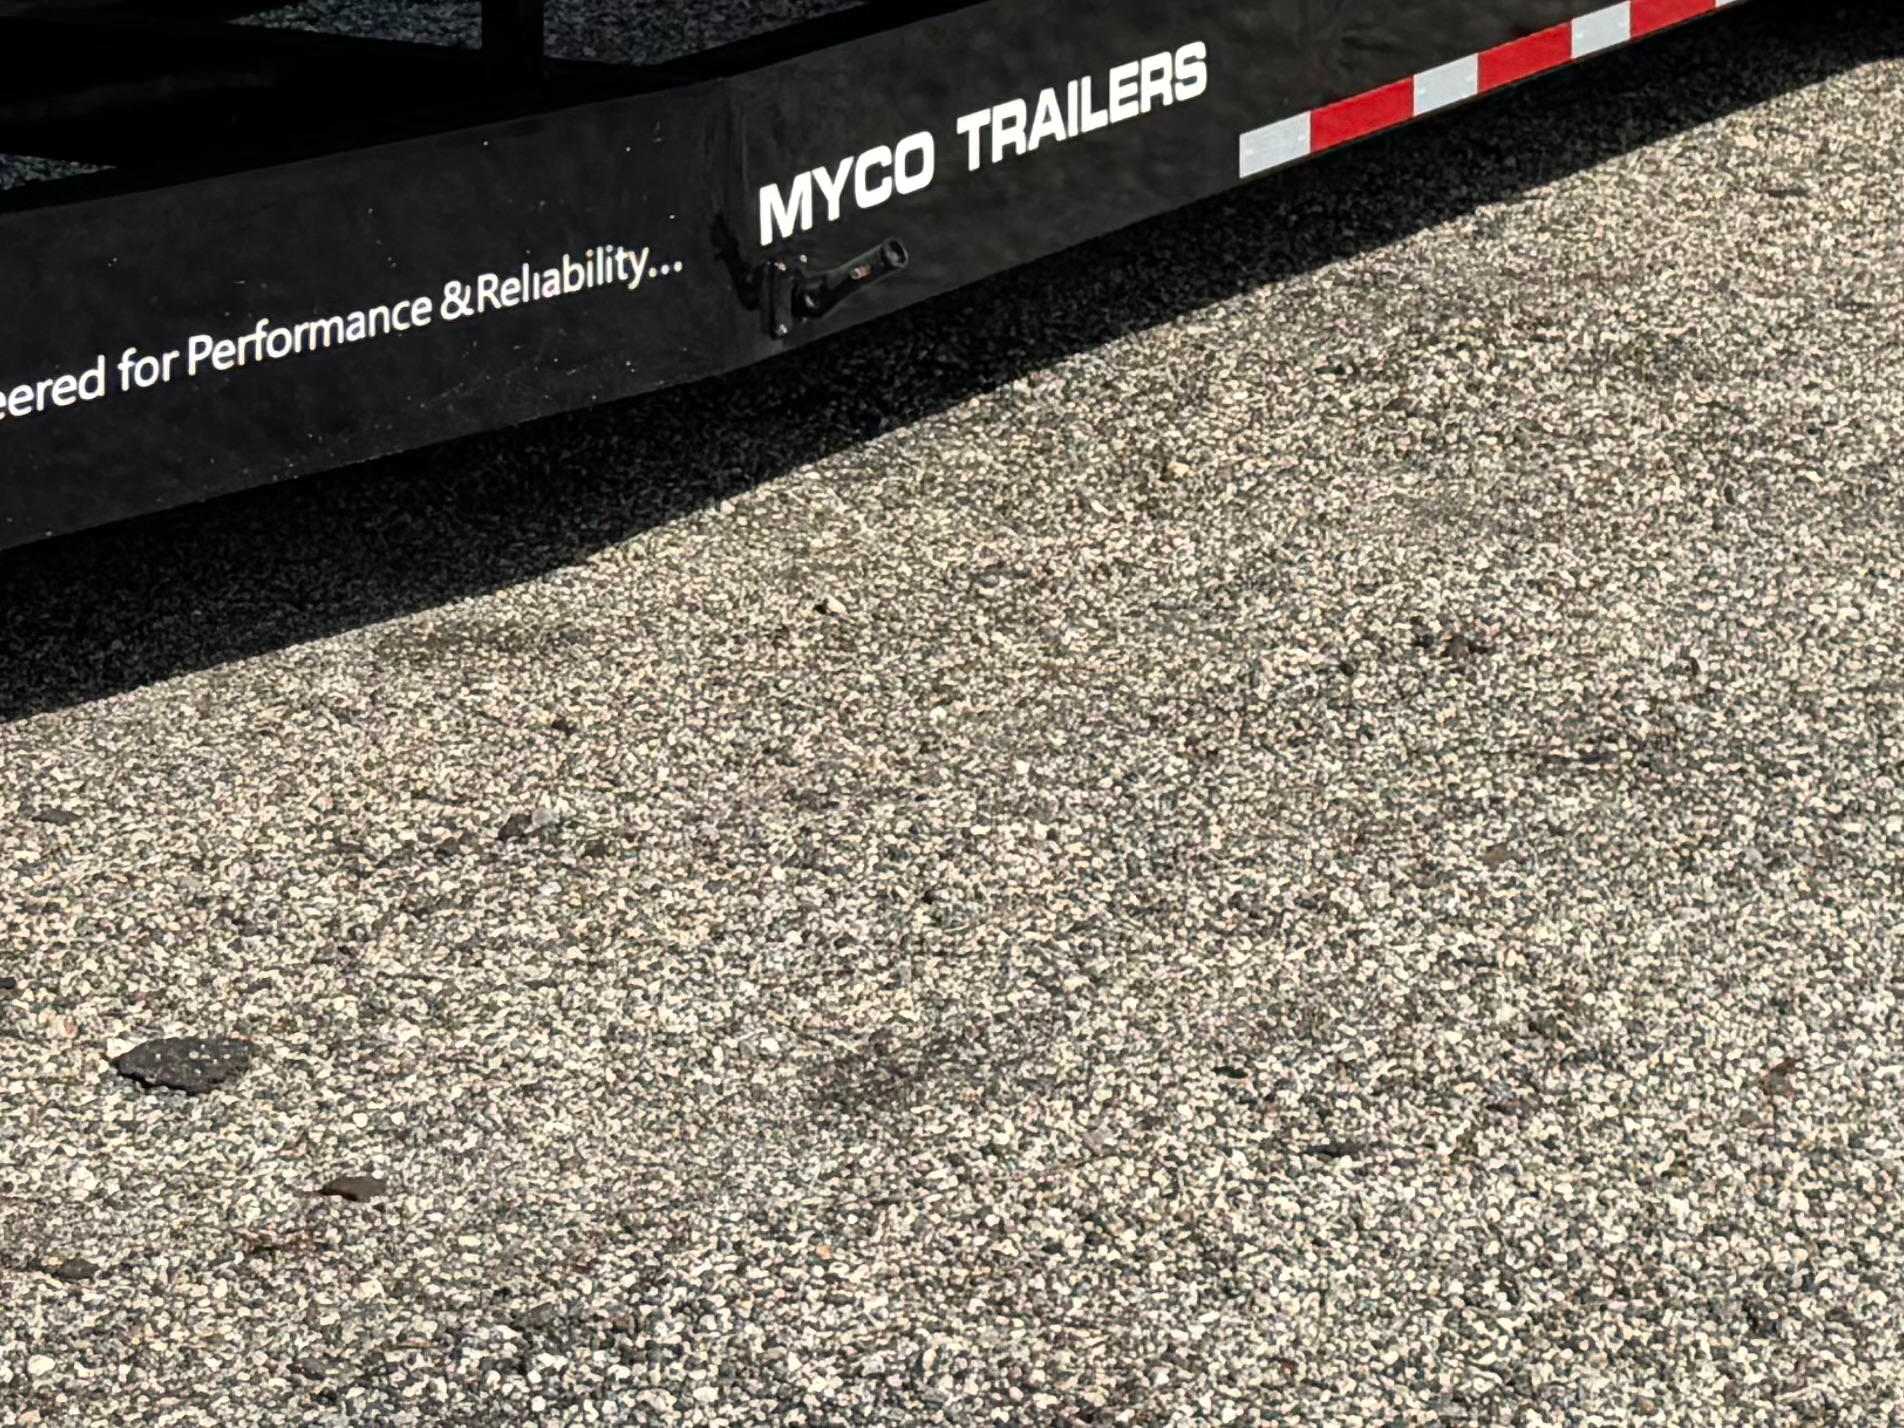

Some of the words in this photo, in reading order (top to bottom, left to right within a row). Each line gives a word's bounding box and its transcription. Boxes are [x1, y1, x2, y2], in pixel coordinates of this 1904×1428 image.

[759, 130, 935, 246] MYCO
[956, 40, 1208, 172] TRAILERS
[116, 346, 181, 392] for
[187, 296, 433, 376] Performance
